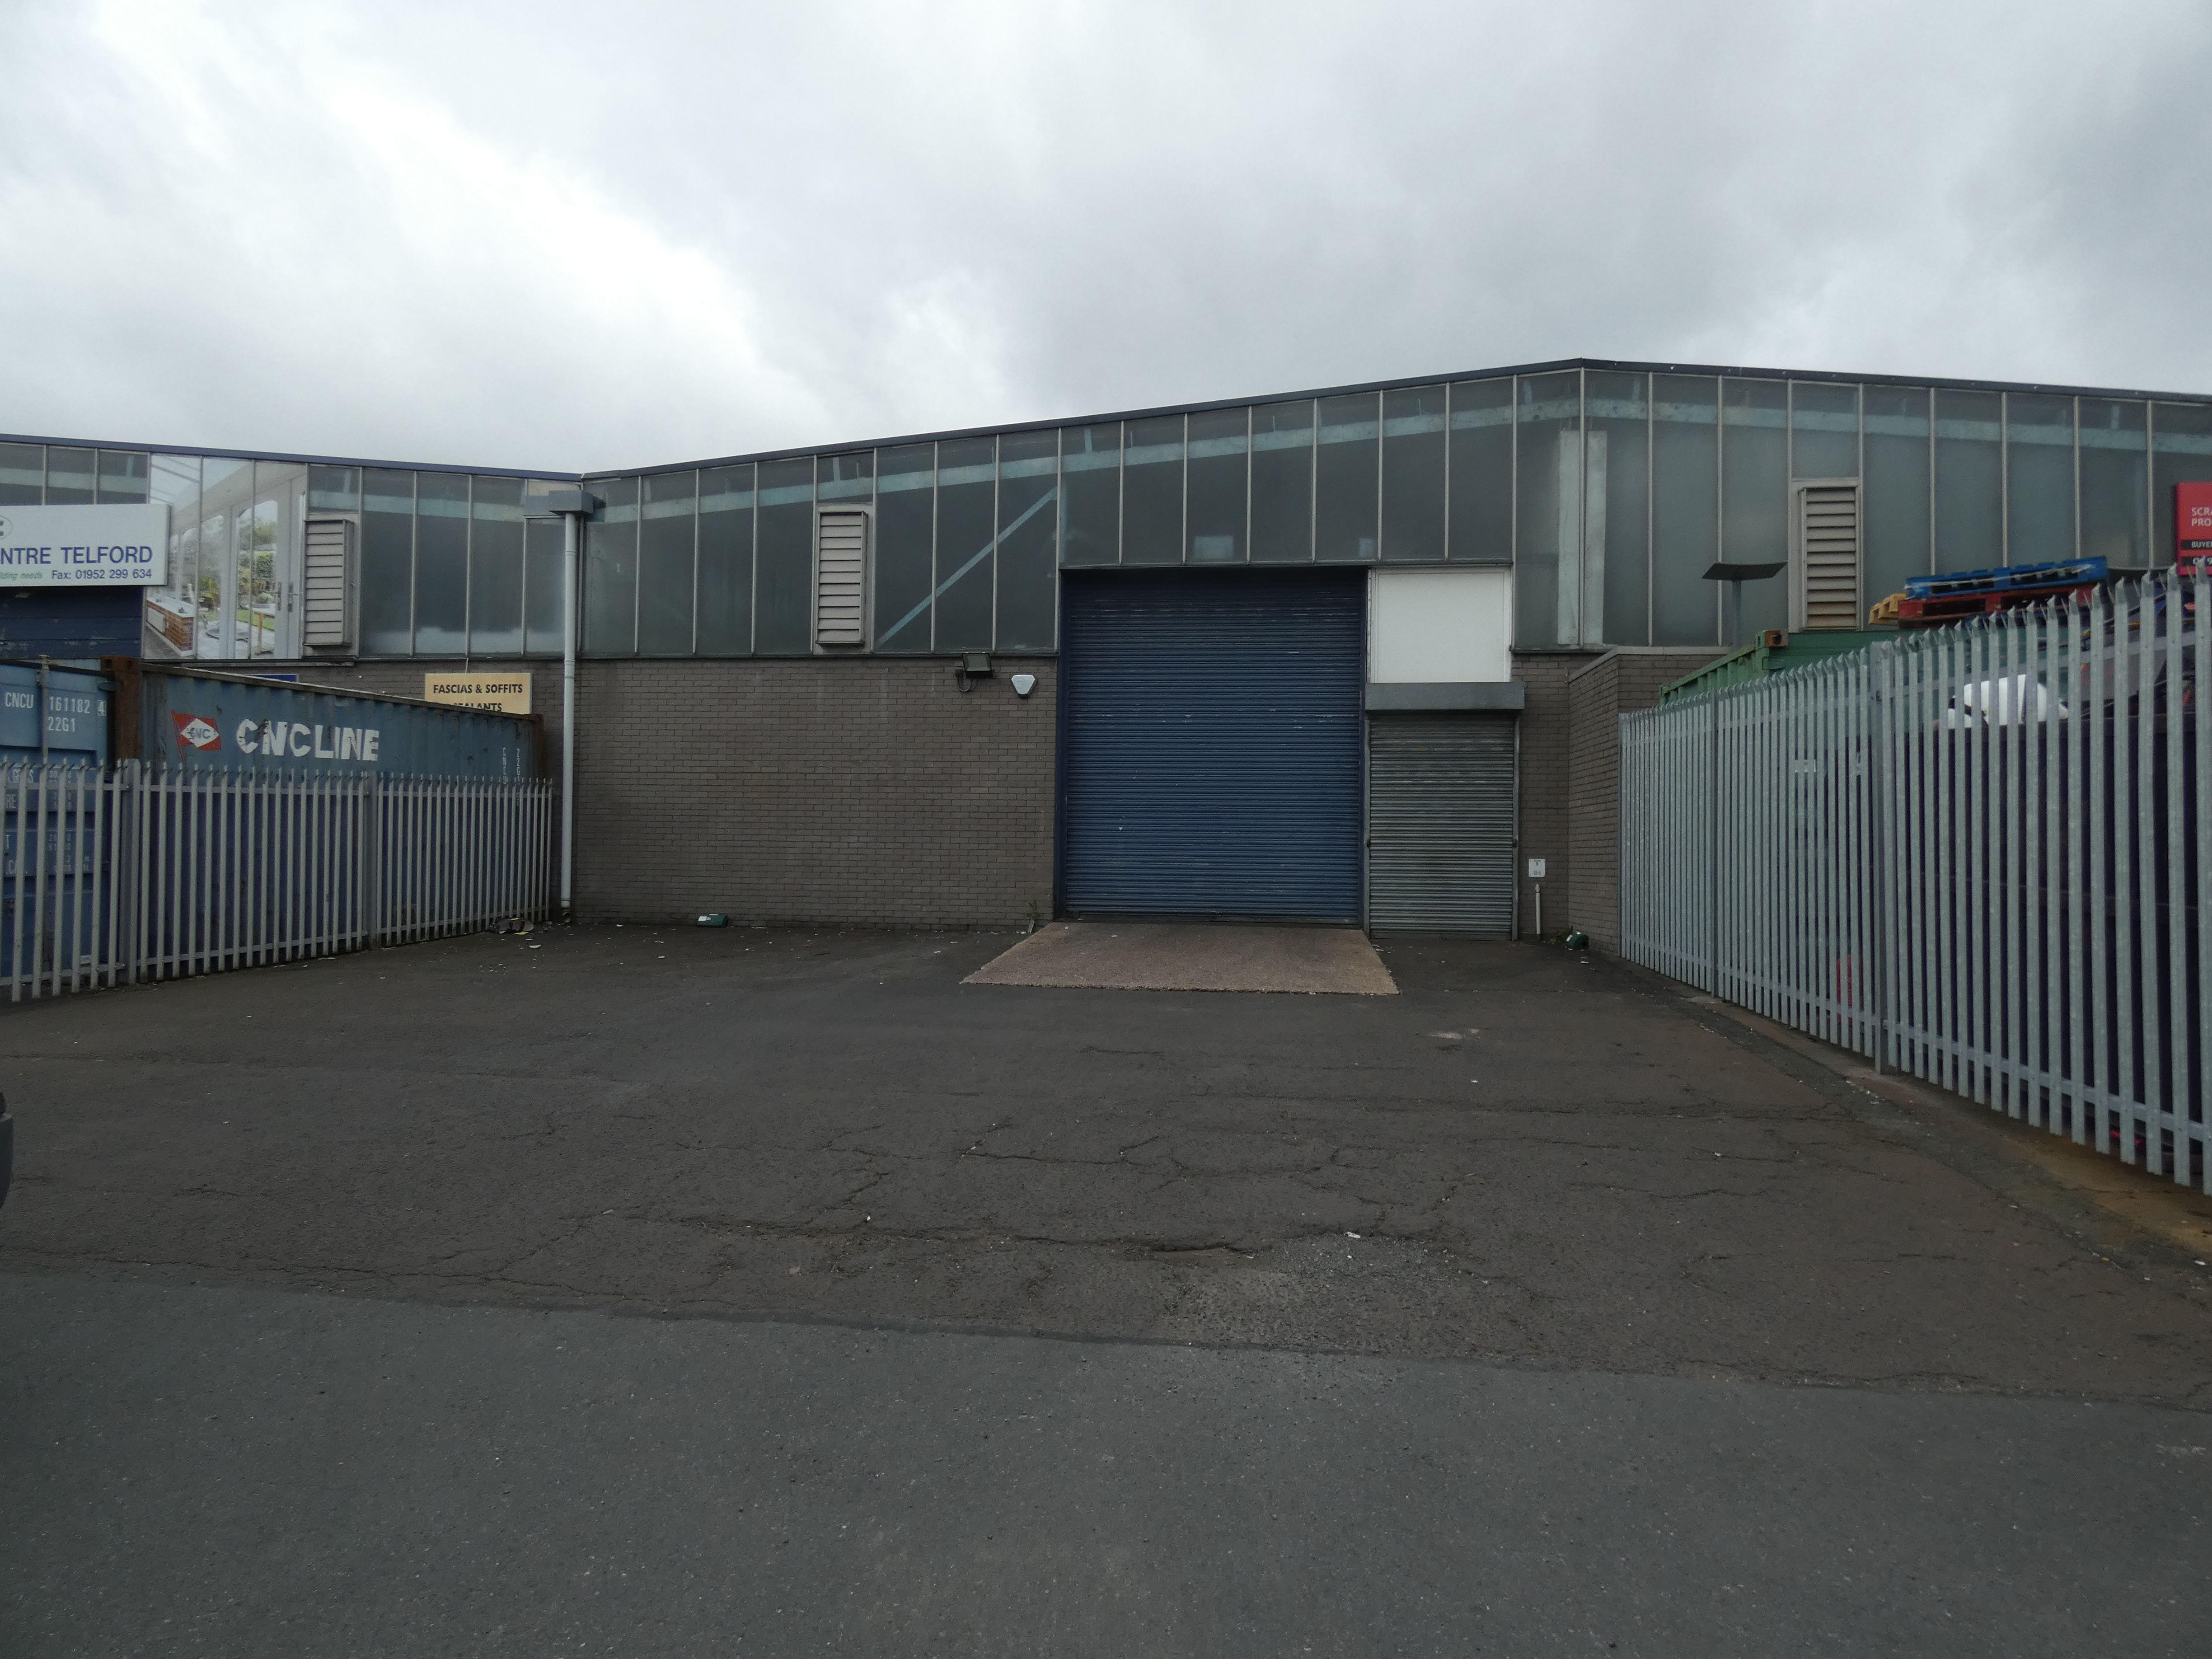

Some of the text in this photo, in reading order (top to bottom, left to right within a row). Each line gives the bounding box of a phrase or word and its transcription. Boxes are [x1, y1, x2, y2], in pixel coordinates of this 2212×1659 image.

[2192, 507, 2212, 516] SCR
[2192, 518, 2212, 527] PRO
[61, 546, 153, 564] TELFORD
[52, 570, 71, 579] Fax:
[75, 569, 105, 579] 01952
[109, 569, 128, 579] 299
[133, 569, 152, 578] 634
[433, 684, 523, 694] FASCIAS & SOFFITS
[5, 692, 105, 716] CNCU 161182 4
[48, 716, 75, 732] 22G1
